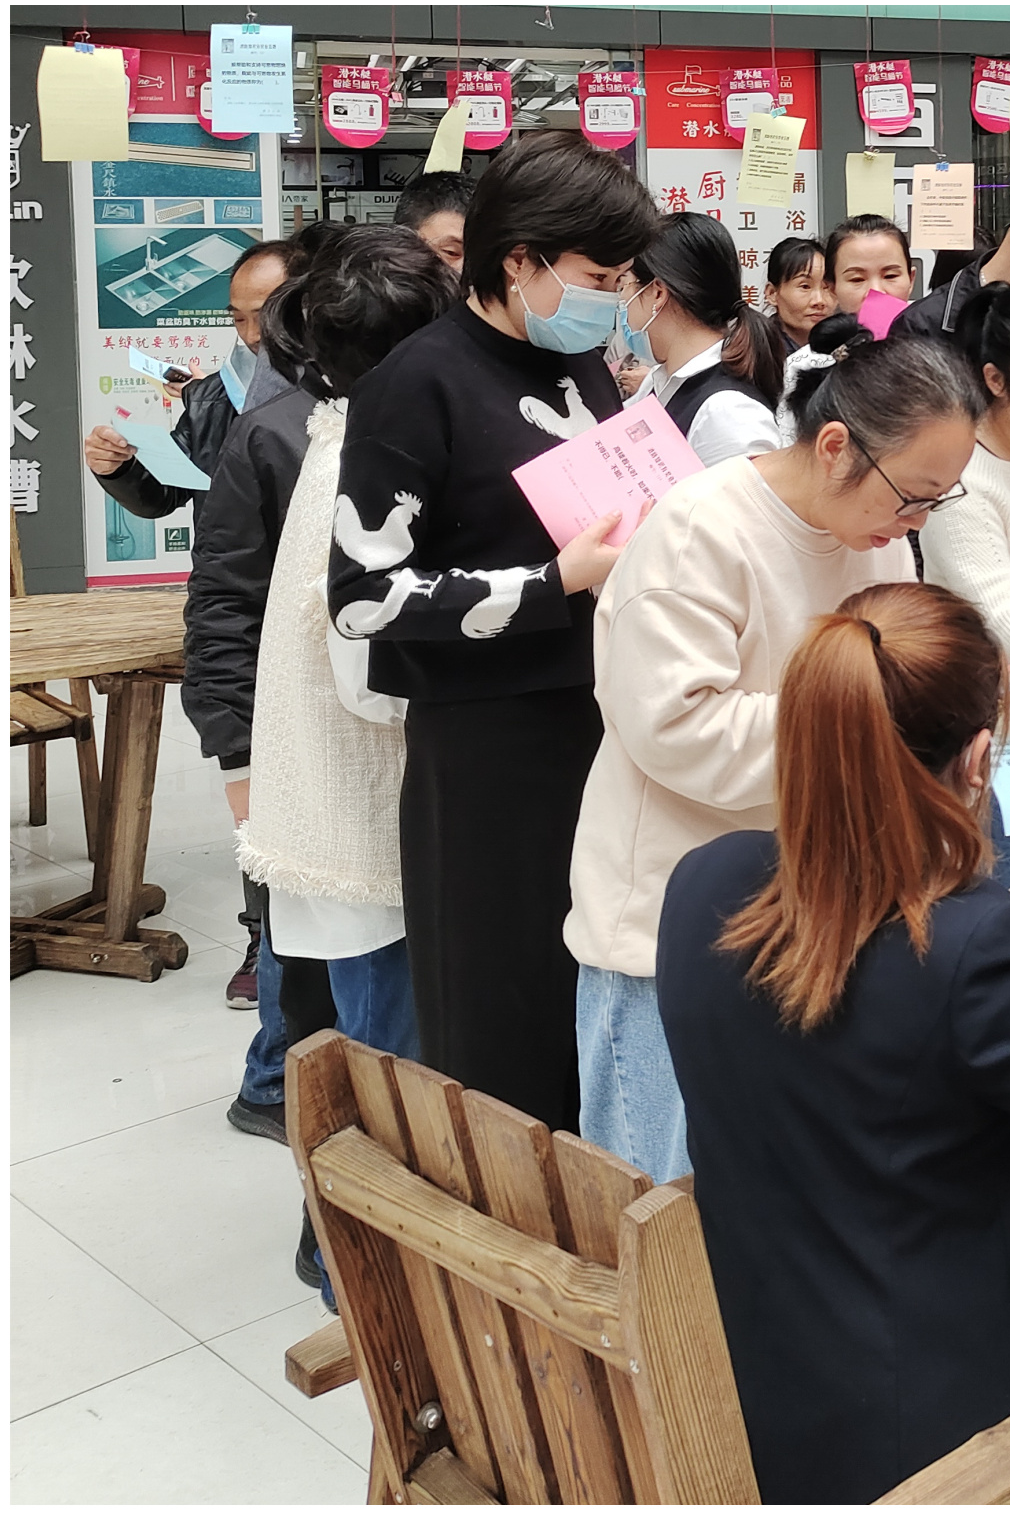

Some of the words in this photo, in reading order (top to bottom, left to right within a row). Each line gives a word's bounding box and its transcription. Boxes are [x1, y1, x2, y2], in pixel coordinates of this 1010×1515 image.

[338, 68, 372, 80] 潜水艇
[462, 71, 494, 82] 潜水艇
[592, 73, 623, 84] 潜水艇
[733, 70, 763, 81] 潜水艇
[682, 119, 732, 138] 潜水
